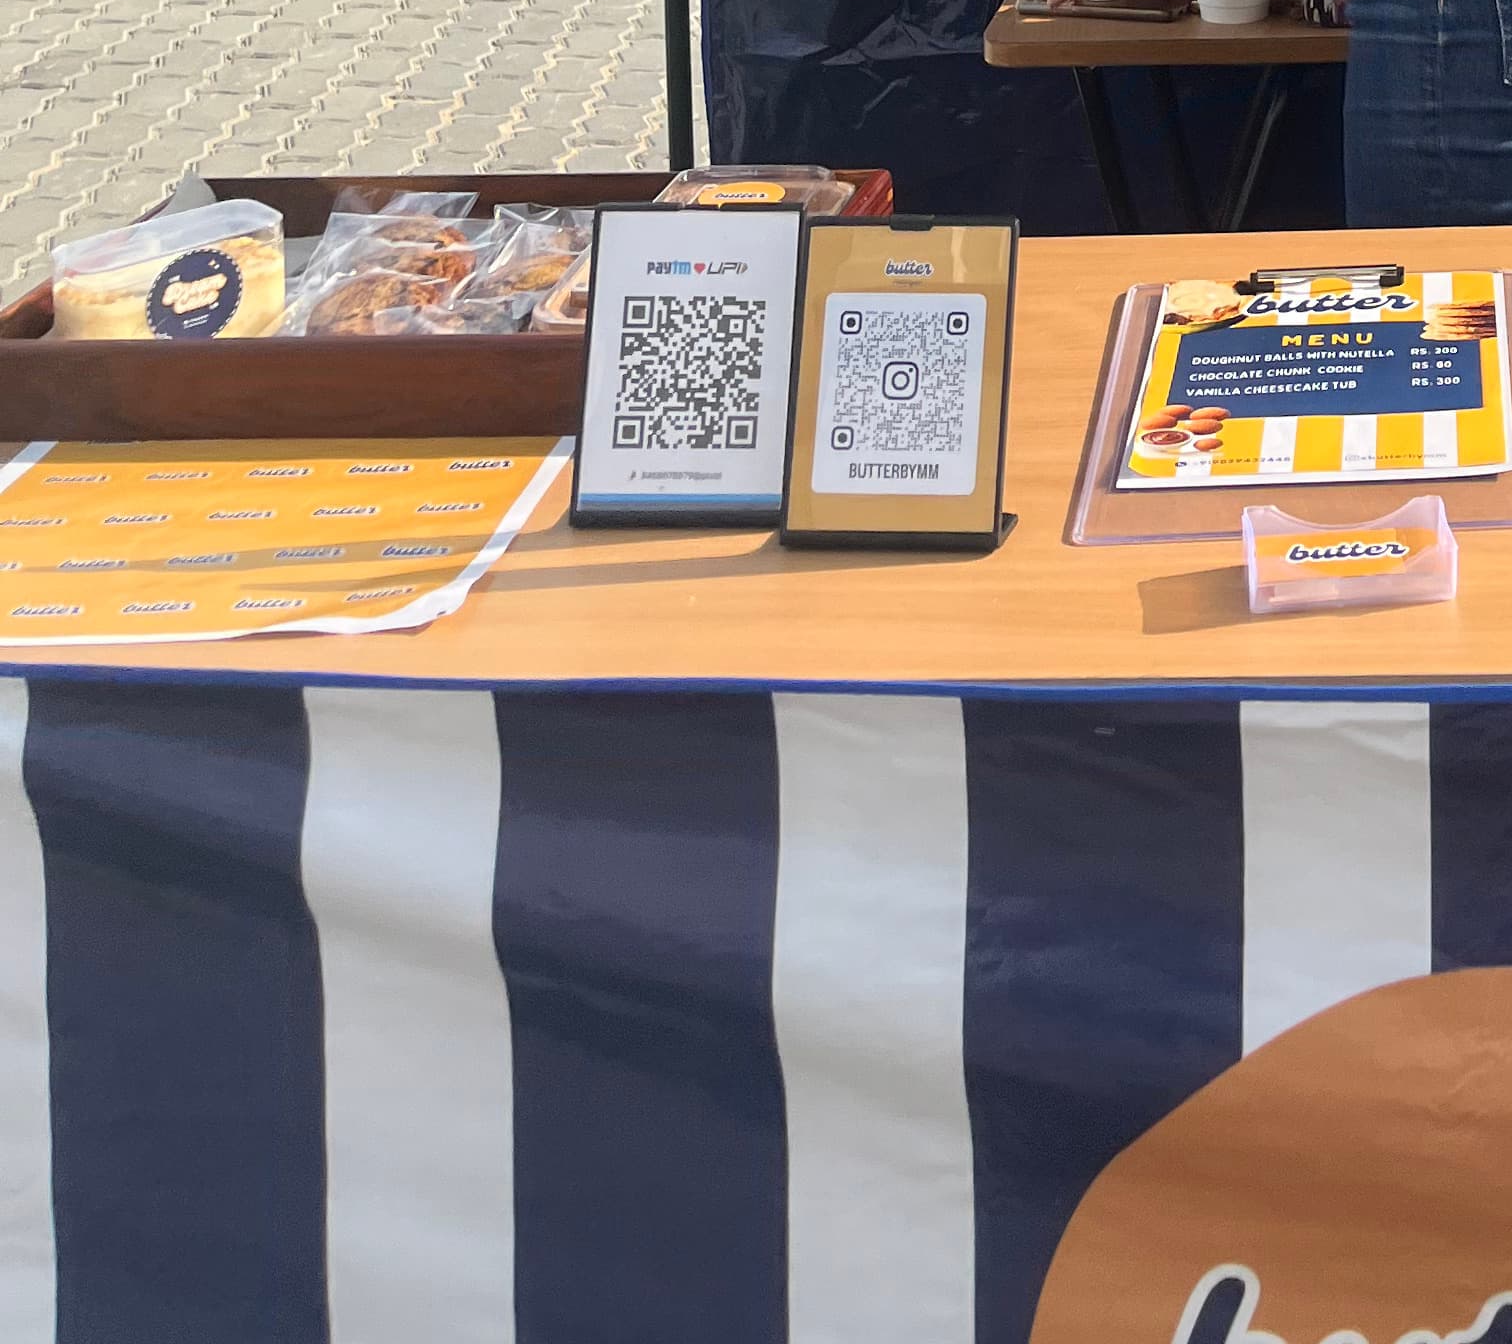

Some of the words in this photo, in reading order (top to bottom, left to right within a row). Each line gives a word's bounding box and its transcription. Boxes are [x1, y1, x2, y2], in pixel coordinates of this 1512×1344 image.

[884, 258, 933, 277] butter
[1245, 292, 1417, 317] butter
[1281, 332, 1374, 348] MENU
[1191, 353, 1262, 366] DOUGHNUT
[1264, 350, 1303, 362] BALLS
[1306, 349, 1338, 360] WITH
[1338, 347, 1396, 359] NUTELLA
[1188, 368, 1264, 382] CHOCOLATE
[1266, 365, 1312, 378] CHUNK
[1317, 364, 1365, 375] COOKIE
[1185, 385, 1242, 398] VANILLA
[1243, 381, 1330, 395] CHEESECAKE
[1332, 379, 1358, 391] TUB
[1436, 375, 1461, 386] 300
[848, 462, 940, 480] BUTTERBYMM
[1287, 541, 1408, 562] butter
